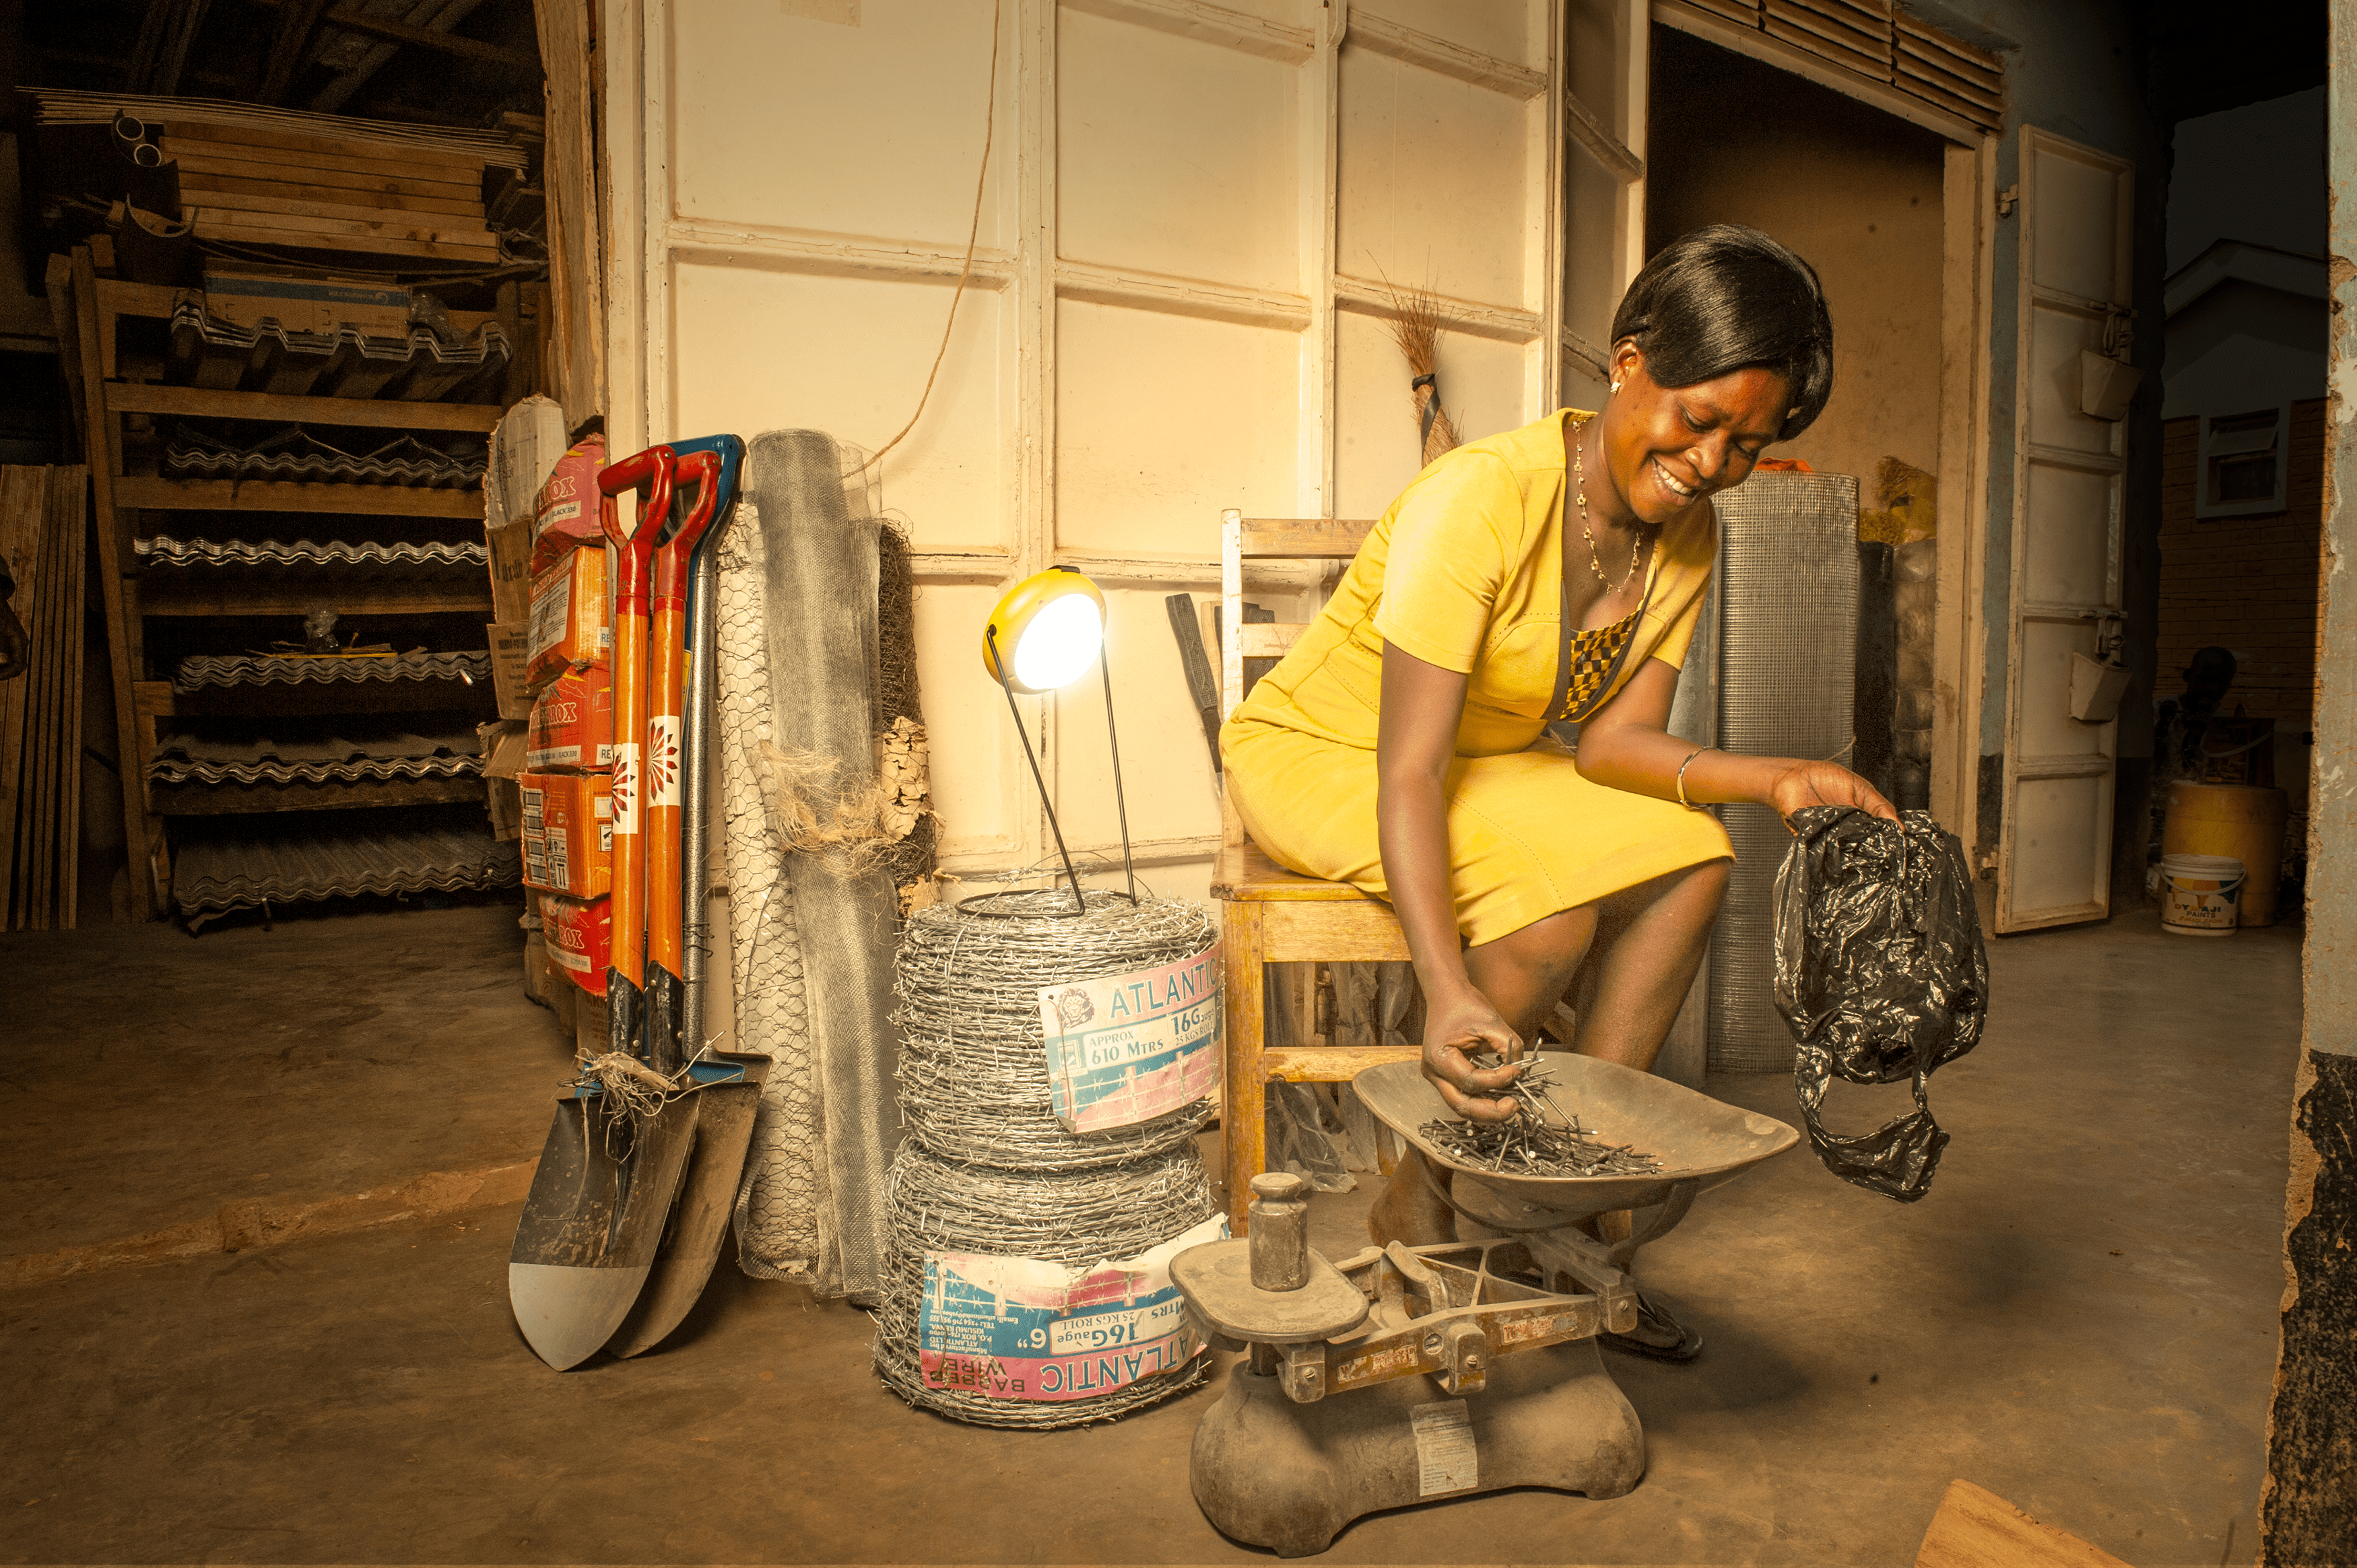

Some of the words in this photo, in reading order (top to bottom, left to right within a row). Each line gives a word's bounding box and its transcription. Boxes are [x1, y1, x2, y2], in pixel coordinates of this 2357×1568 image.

[2187, 911, 2216, 919] PAINTS
[1110, 956, 1218, 1019] ATLANTIC
[1089, 1030, 1134, 1048] APPROX
[1176, 1035, 1184, 1046] 25
[1185, 1028, 1199, 1043] KGS
[1199, 1021, 1214, 1037] ROLL
[1092, 1046, 1120, 1064] 610
[997, 1316, 1019, 1325] Email:
[1096, 1314, 1119, 1326] KGS
[1123, 1311, 1135, 1322] 25
[963, 1319, 979, 1327] +254
[1060, 1317, 1093, 1330] ROLL
[955, 1326, 985, 1334] KISUMU
[1041, 1328, 1191, 1393] ATLANTIC
